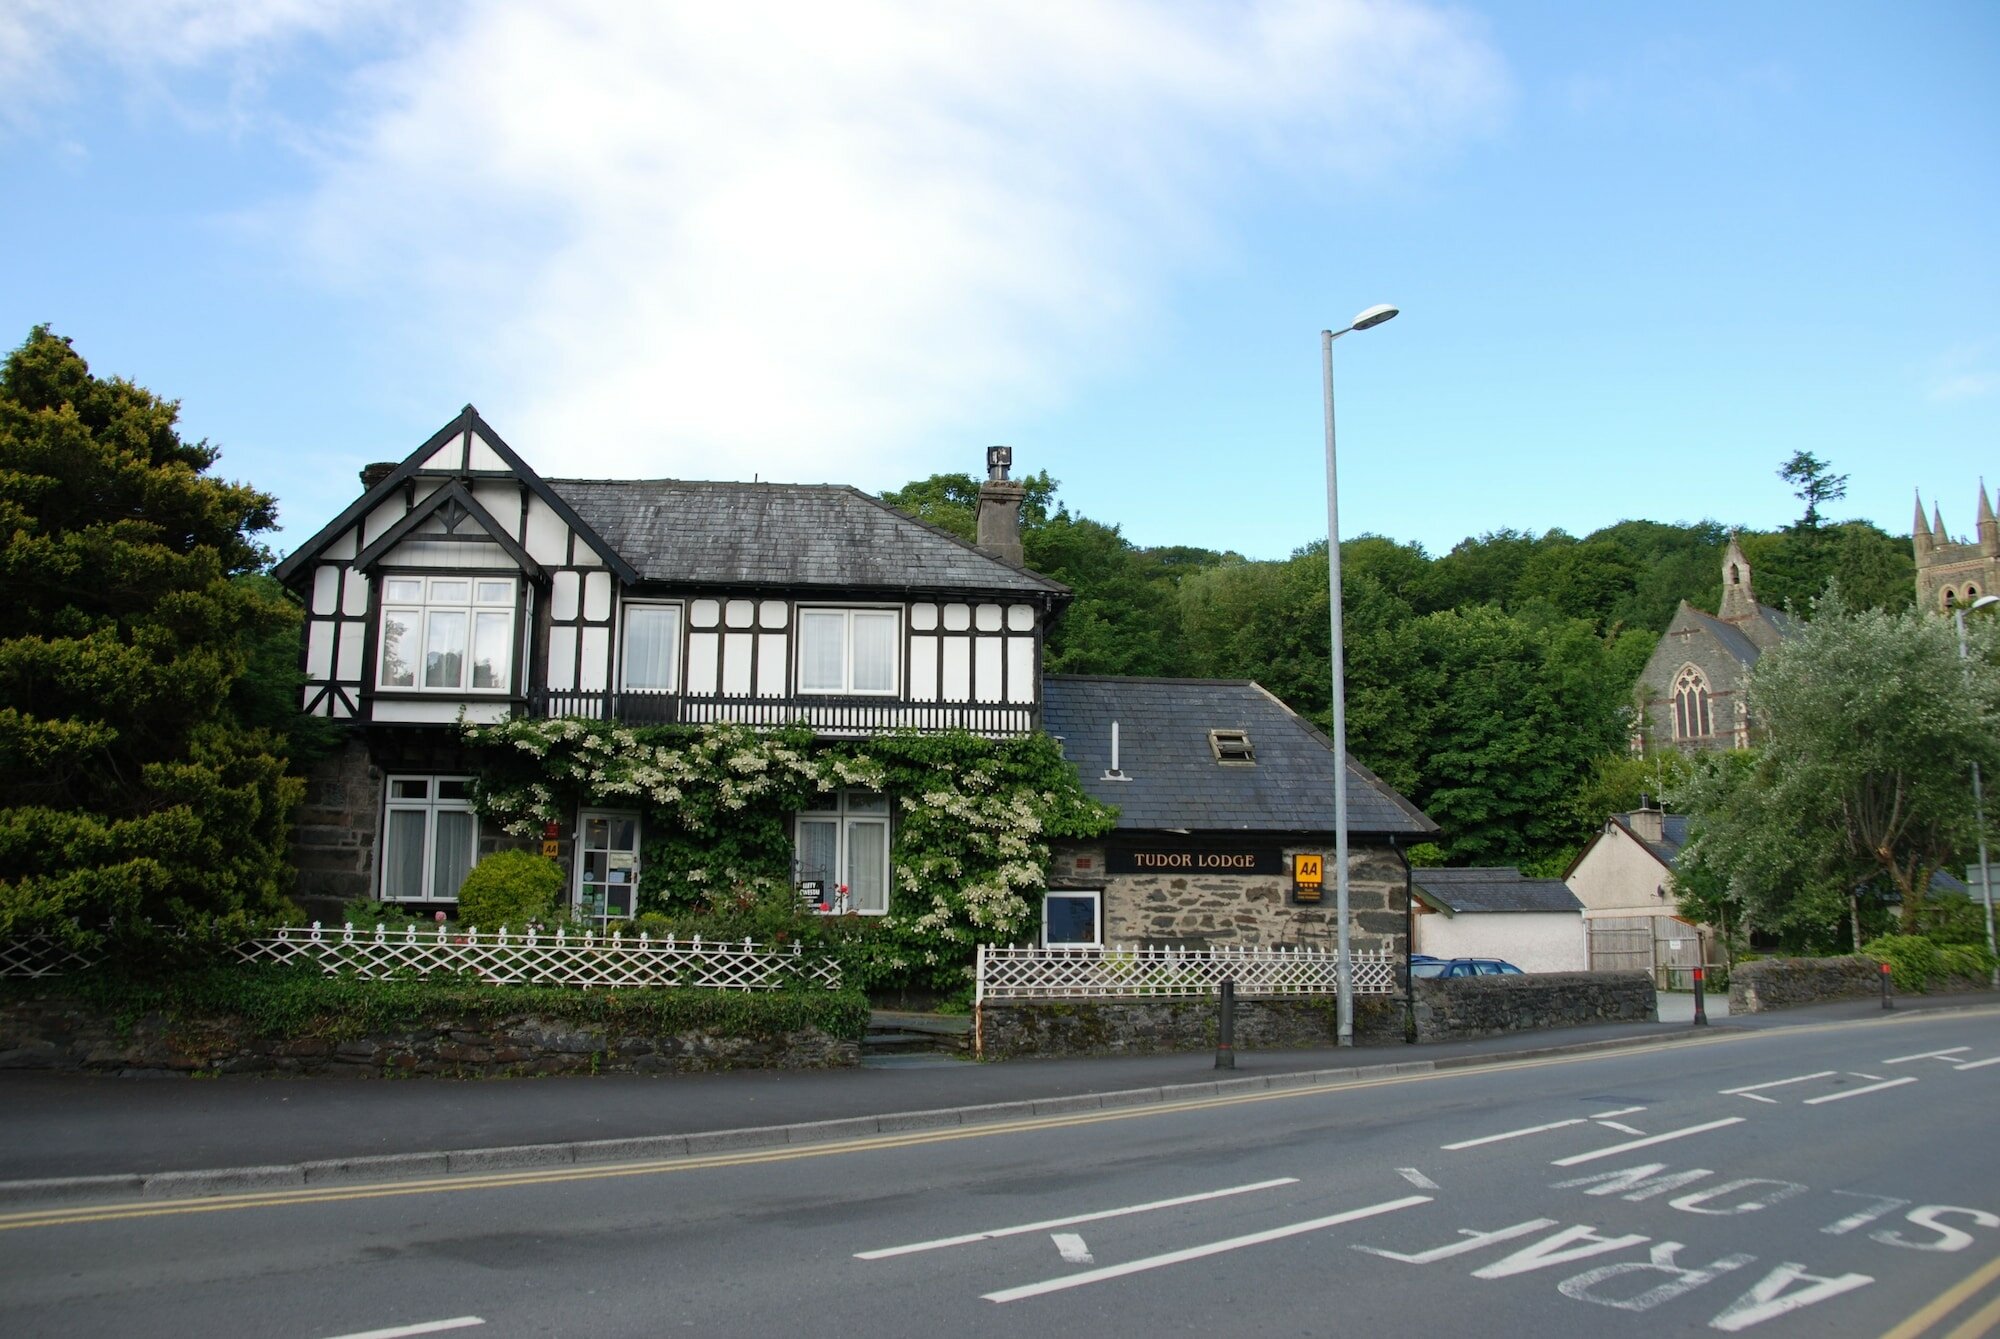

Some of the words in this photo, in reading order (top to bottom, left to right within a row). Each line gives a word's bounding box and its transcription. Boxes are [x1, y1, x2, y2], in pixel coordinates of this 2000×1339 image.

[545, 844, 556, 853] AA
[1134, 853, 1193, 867] TUDOR
[1198, 854, 1256, 868] LODGE
[1300, 862, 1317, 875] AA
[1549, 1163, 2000, 1252] SLOW
[1347, 1217, 1875, 1332] ARAF
